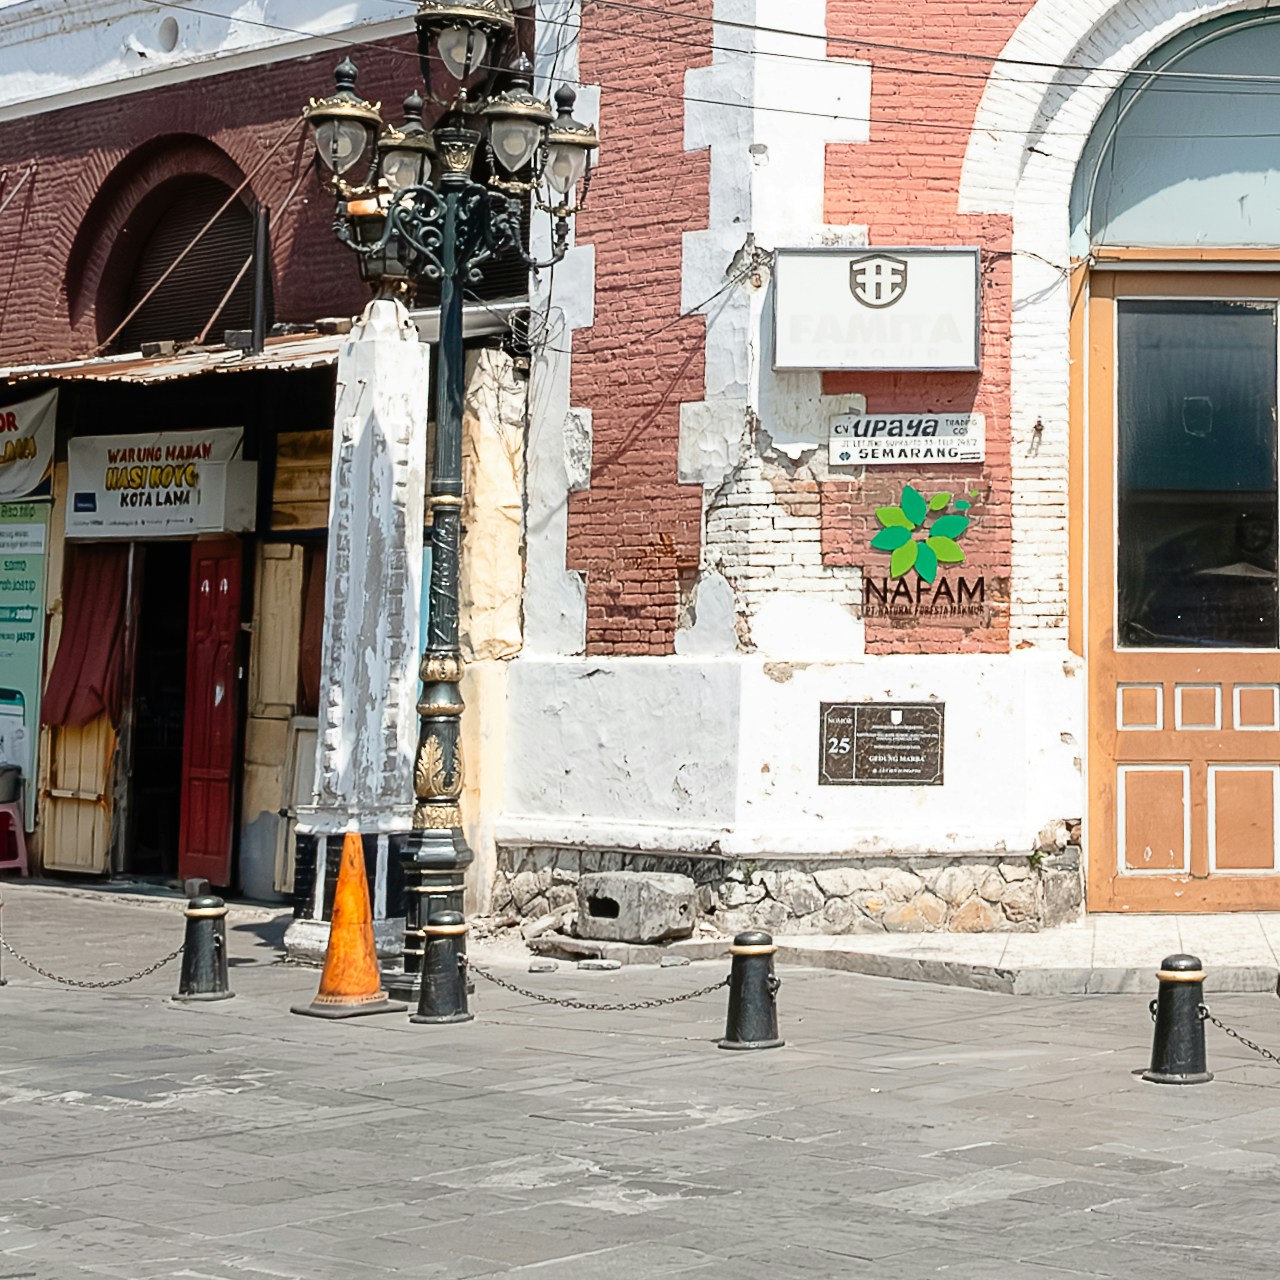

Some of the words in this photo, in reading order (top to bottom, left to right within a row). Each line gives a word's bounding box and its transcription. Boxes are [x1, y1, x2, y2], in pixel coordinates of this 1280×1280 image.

[789, 313, 963, 344] FAMITA
[834, 424, 849, 434] CV
[107, 447, 162, 464] WARUNG
[858, 448, 959, 458] SEMARANG
[105, 465, 148, 491] NASI
[120, 491, 152, 507] KOTA
[155, 490, 190, 506] LAMA
[864, 576, 985, 603] NAFAM
[828, 737, 851, 754] 25
